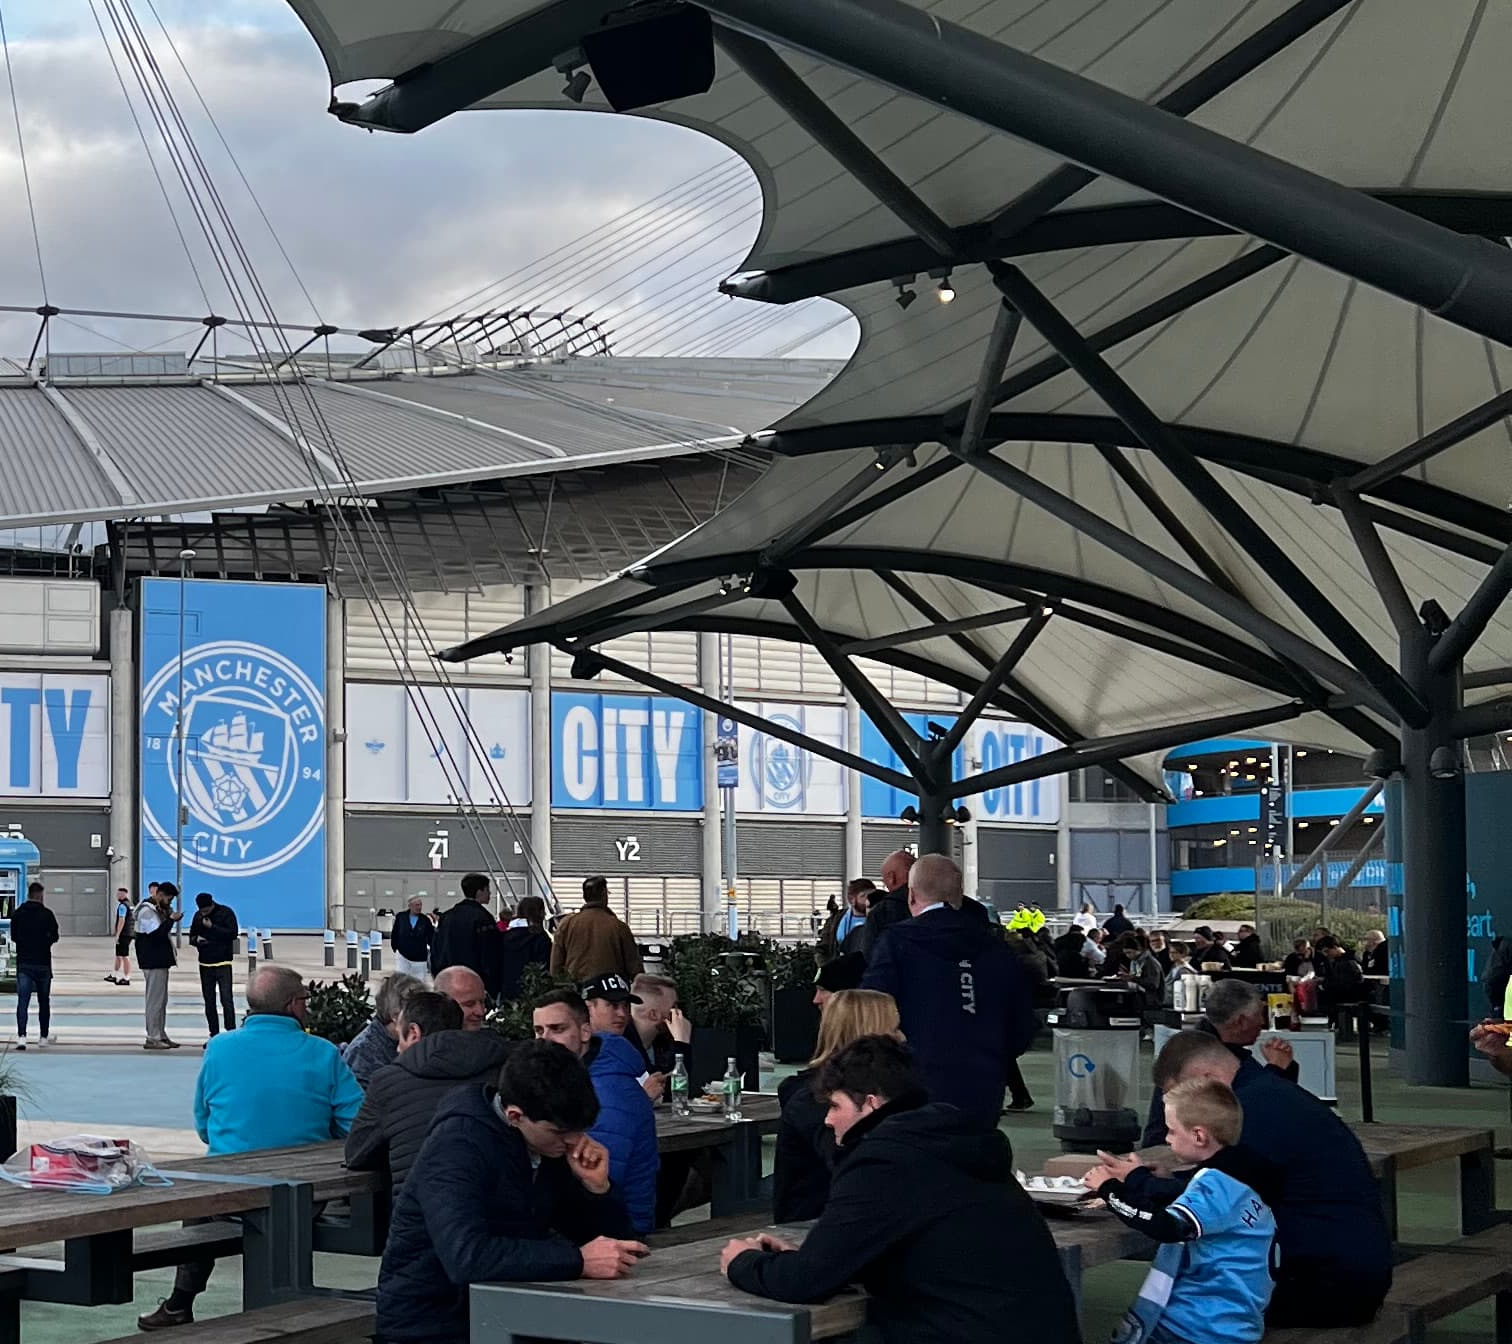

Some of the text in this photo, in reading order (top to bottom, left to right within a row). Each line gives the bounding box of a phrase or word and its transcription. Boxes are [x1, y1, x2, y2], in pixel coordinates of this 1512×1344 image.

[158, 660, 318, 744] MANCHESTER
[146, 737, 161, 750] 18
[562, 706, 685, 803] CITY
[302, 766, 321, 781] 94
[982, 731, 1043, 816] CITY
[192, 832, 252, 859] CITY
[428, 837, 449, 858] Z1
[615, 840, 641, 861] Y2
[960, 972, 976, 1014] CITY
